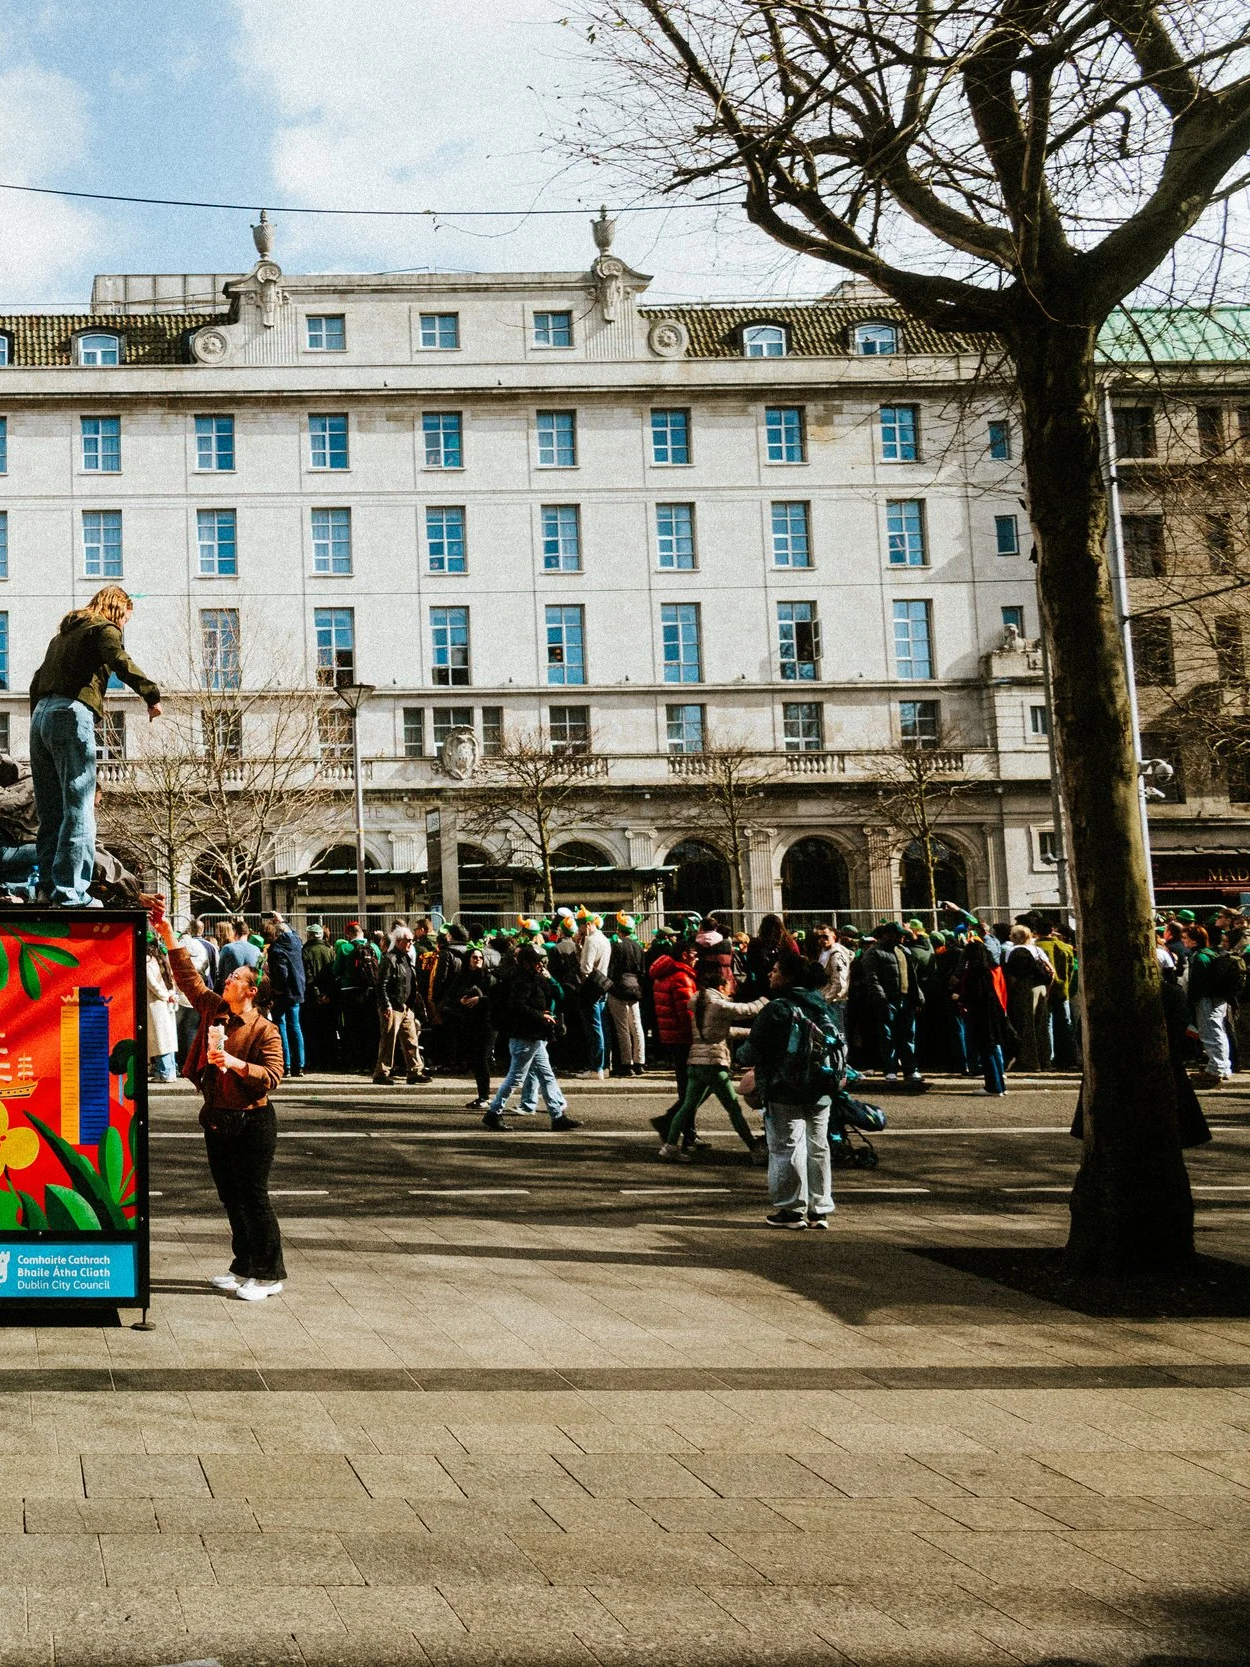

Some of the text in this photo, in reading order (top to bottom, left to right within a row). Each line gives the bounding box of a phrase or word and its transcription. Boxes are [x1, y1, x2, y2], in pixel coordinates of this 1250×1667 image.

[17, 1255, 110, 1265] Comhairle Cathrach
[17, 1265, 110, 1277] Bhaile Átha Cliath
[17, 1280, 110, 1291] Dublin City Council
